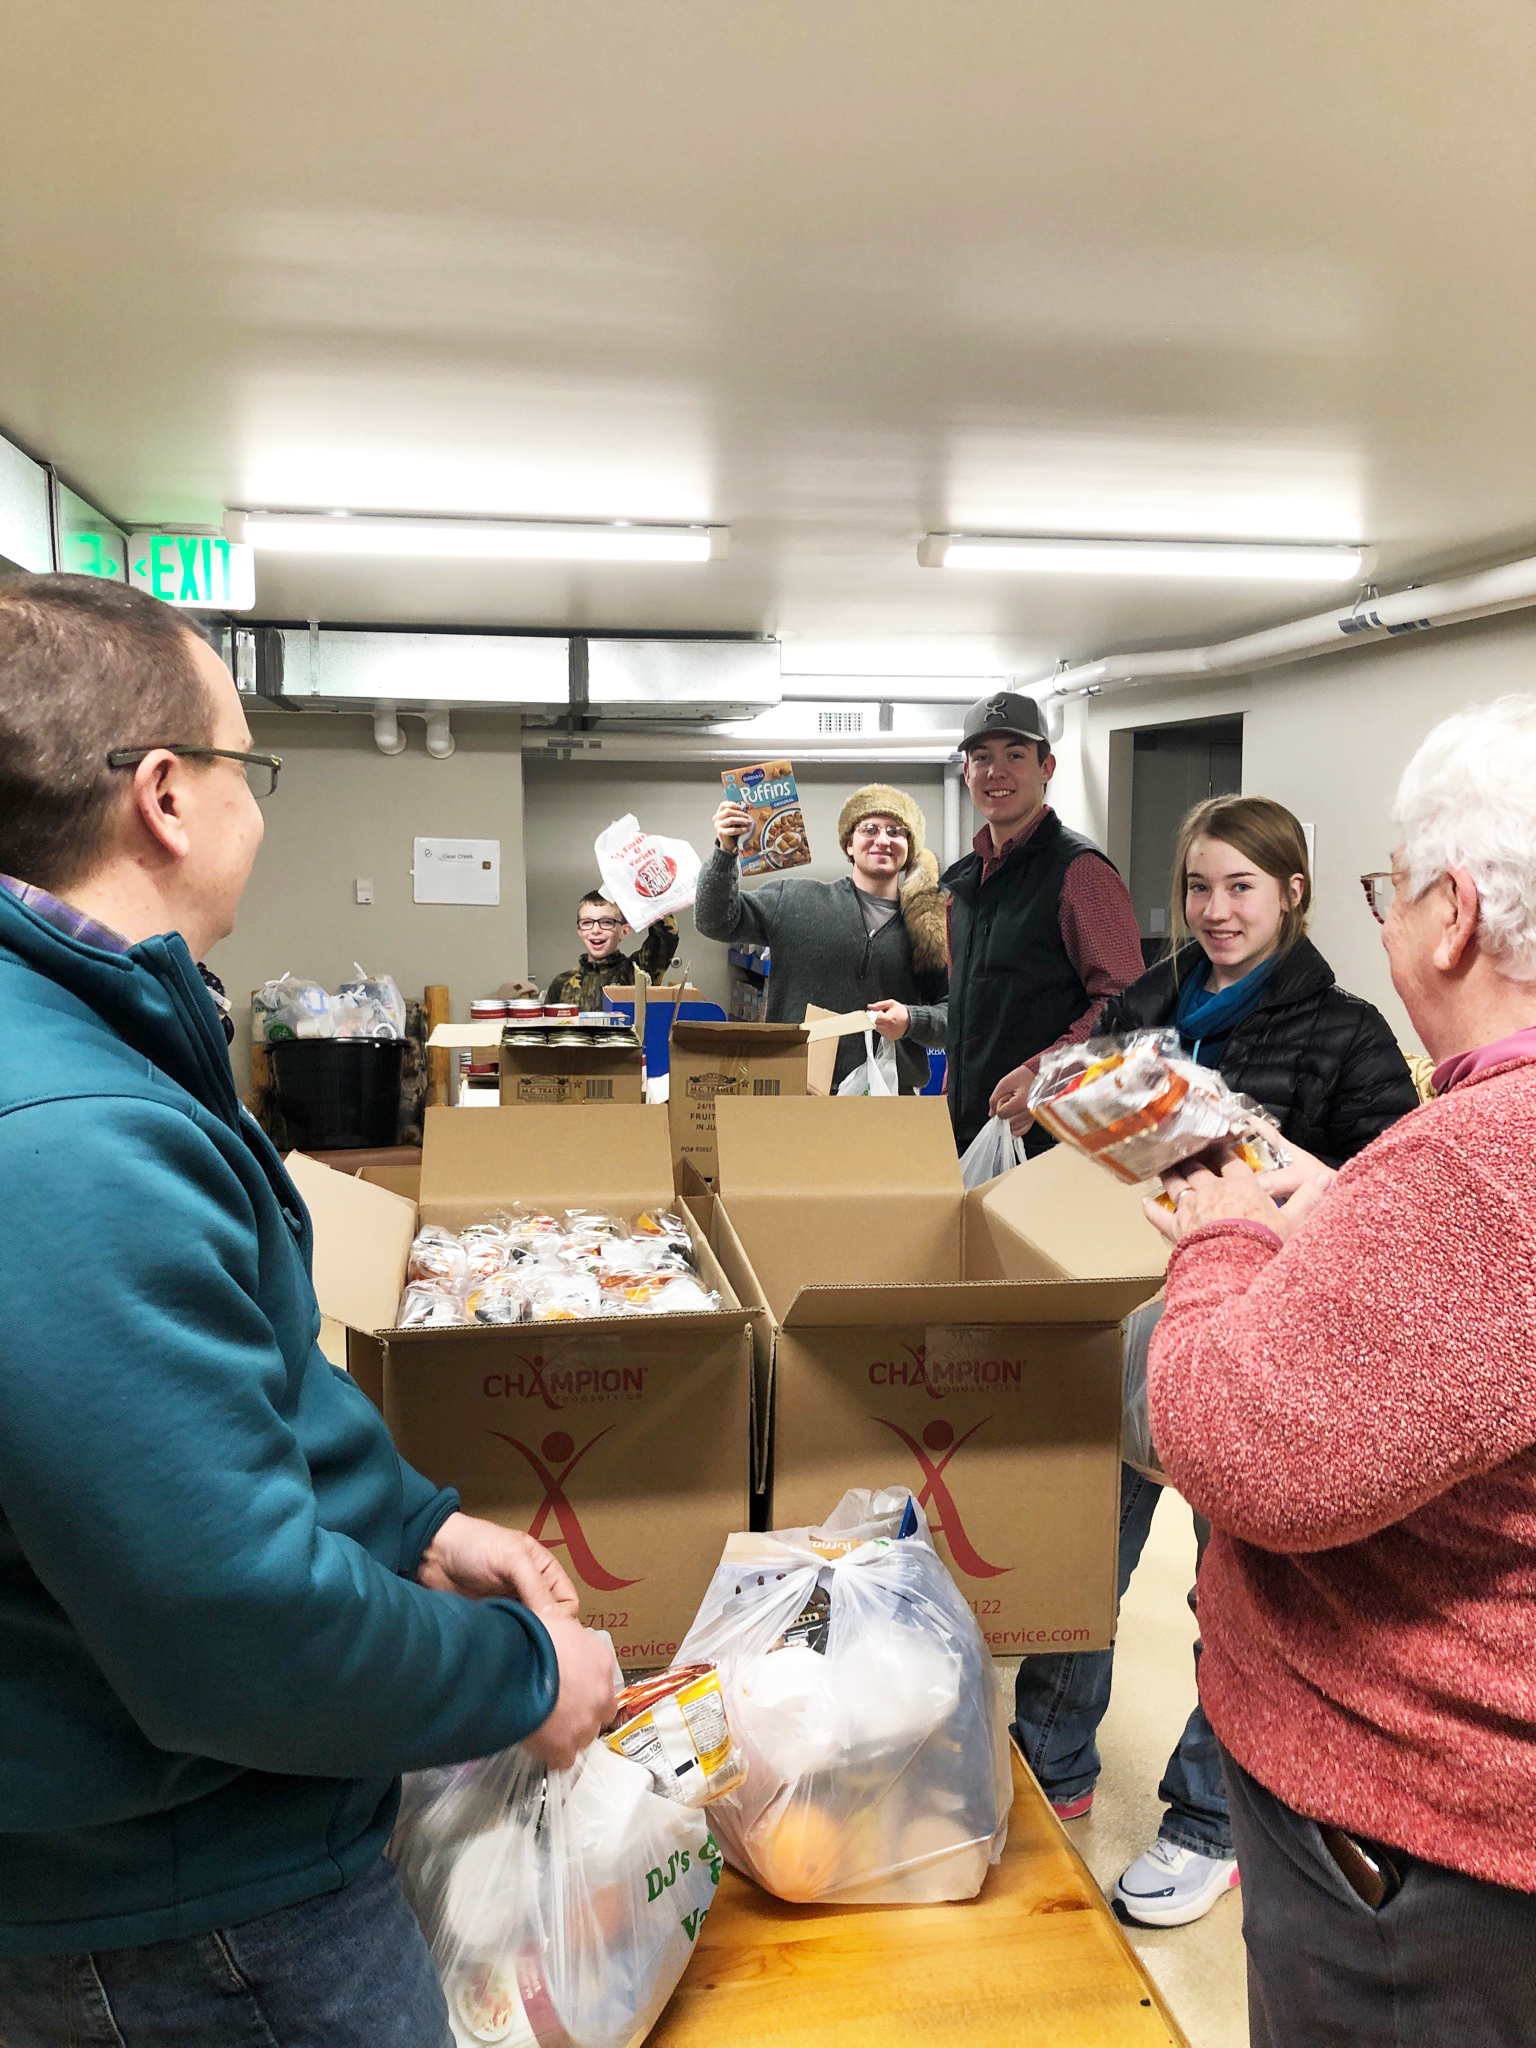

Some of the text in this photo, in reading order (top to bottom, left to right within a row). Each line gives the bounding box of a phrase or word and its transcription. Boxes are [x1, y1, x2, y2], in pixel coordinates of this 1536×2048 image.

[150, 535, 236, 601] EXIT
[740, 781, 791, 803] Puffins
[629, 847, 656, 867] Variety
[645, 868, 672, 897] FAMILY
[690, 1113, 716, 1121] FRUIT
[483, 1361, 645, 1404] CHAMPION
[869, 1352, 1023, 1393] CHAMPION
[649, 1741, 662, 1753] 100
[645, 1850, 690, 1903] DJ's
